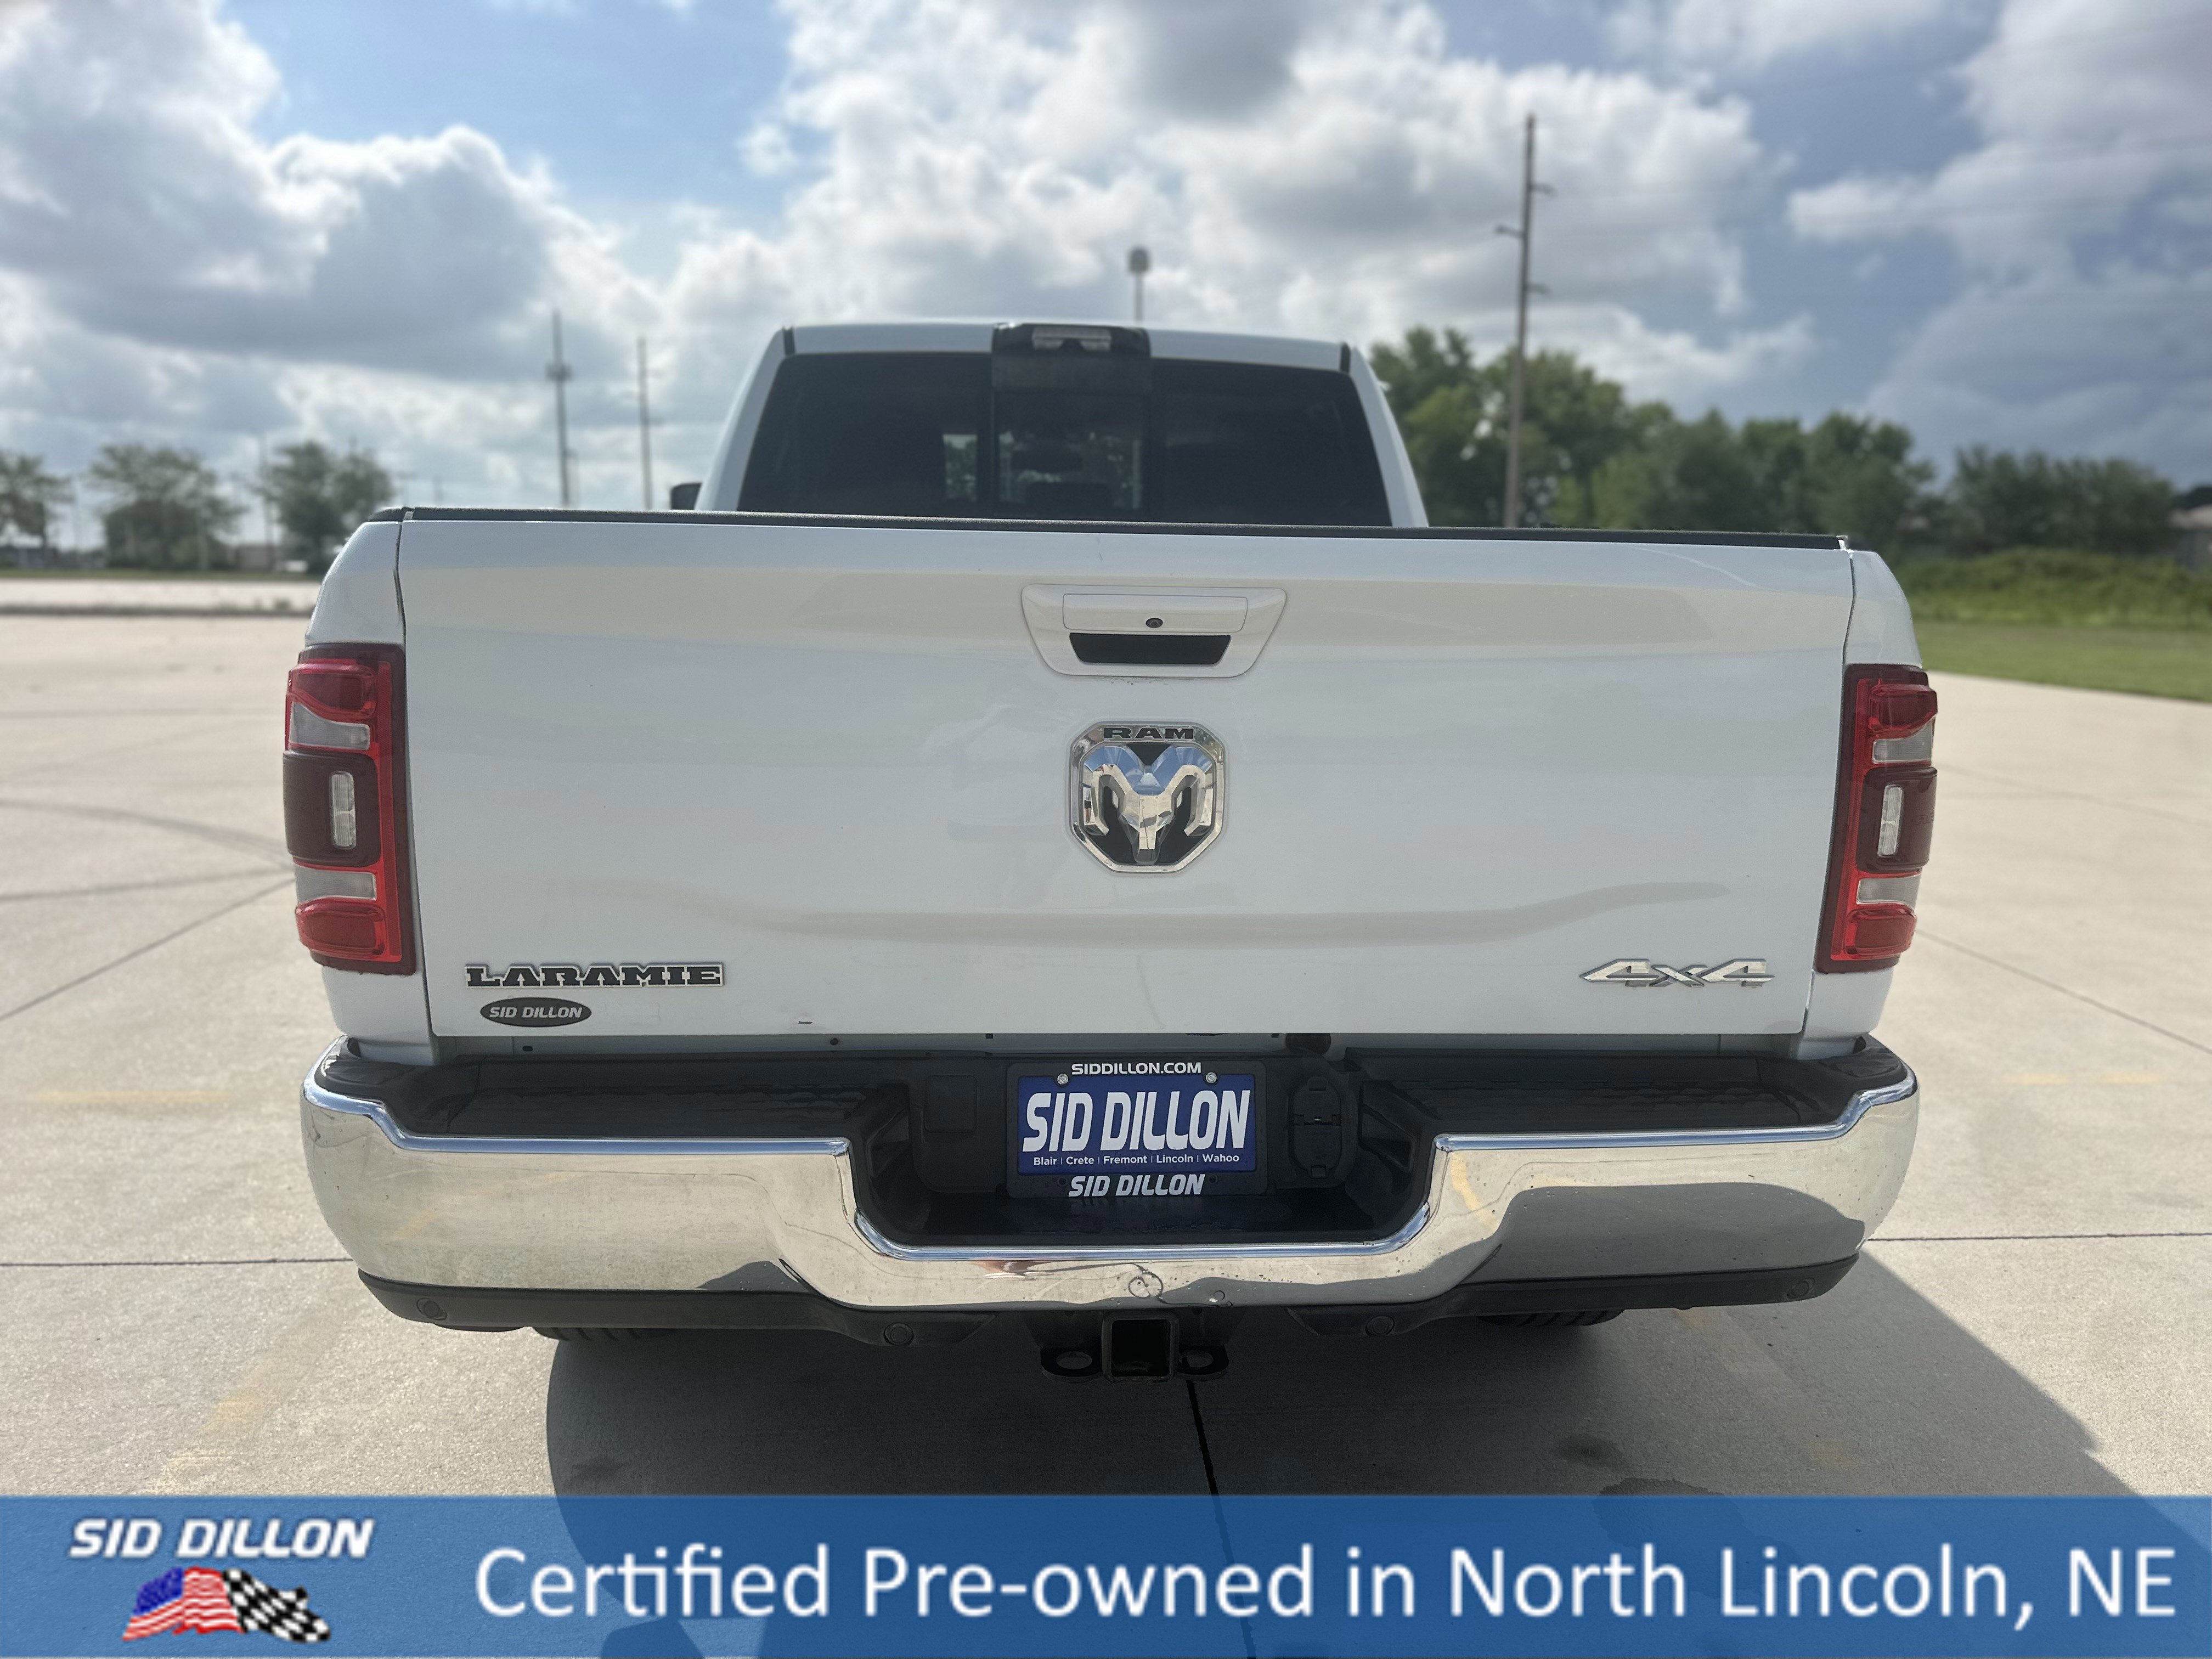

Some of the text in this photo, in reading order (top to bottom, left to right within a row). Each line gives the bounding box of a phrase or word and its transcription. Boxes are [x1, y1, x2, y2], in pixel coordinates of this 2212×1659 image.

[1103, 727, 1194, 740] RAM
[466, 963, 724, 987] LARAMIE
[489, 1007, 583, 1019] SID DILLON
[1071, 1062, 1201, 1075] SIDDILLON.COM
[1022, 1090, 1251, 1152] SID DILLON
[1033, 1154, 1240, 1166] Blair Crete Fremont Lincoln Wahoo
[1068, 1174, 1205, 1197] SID DILLON
